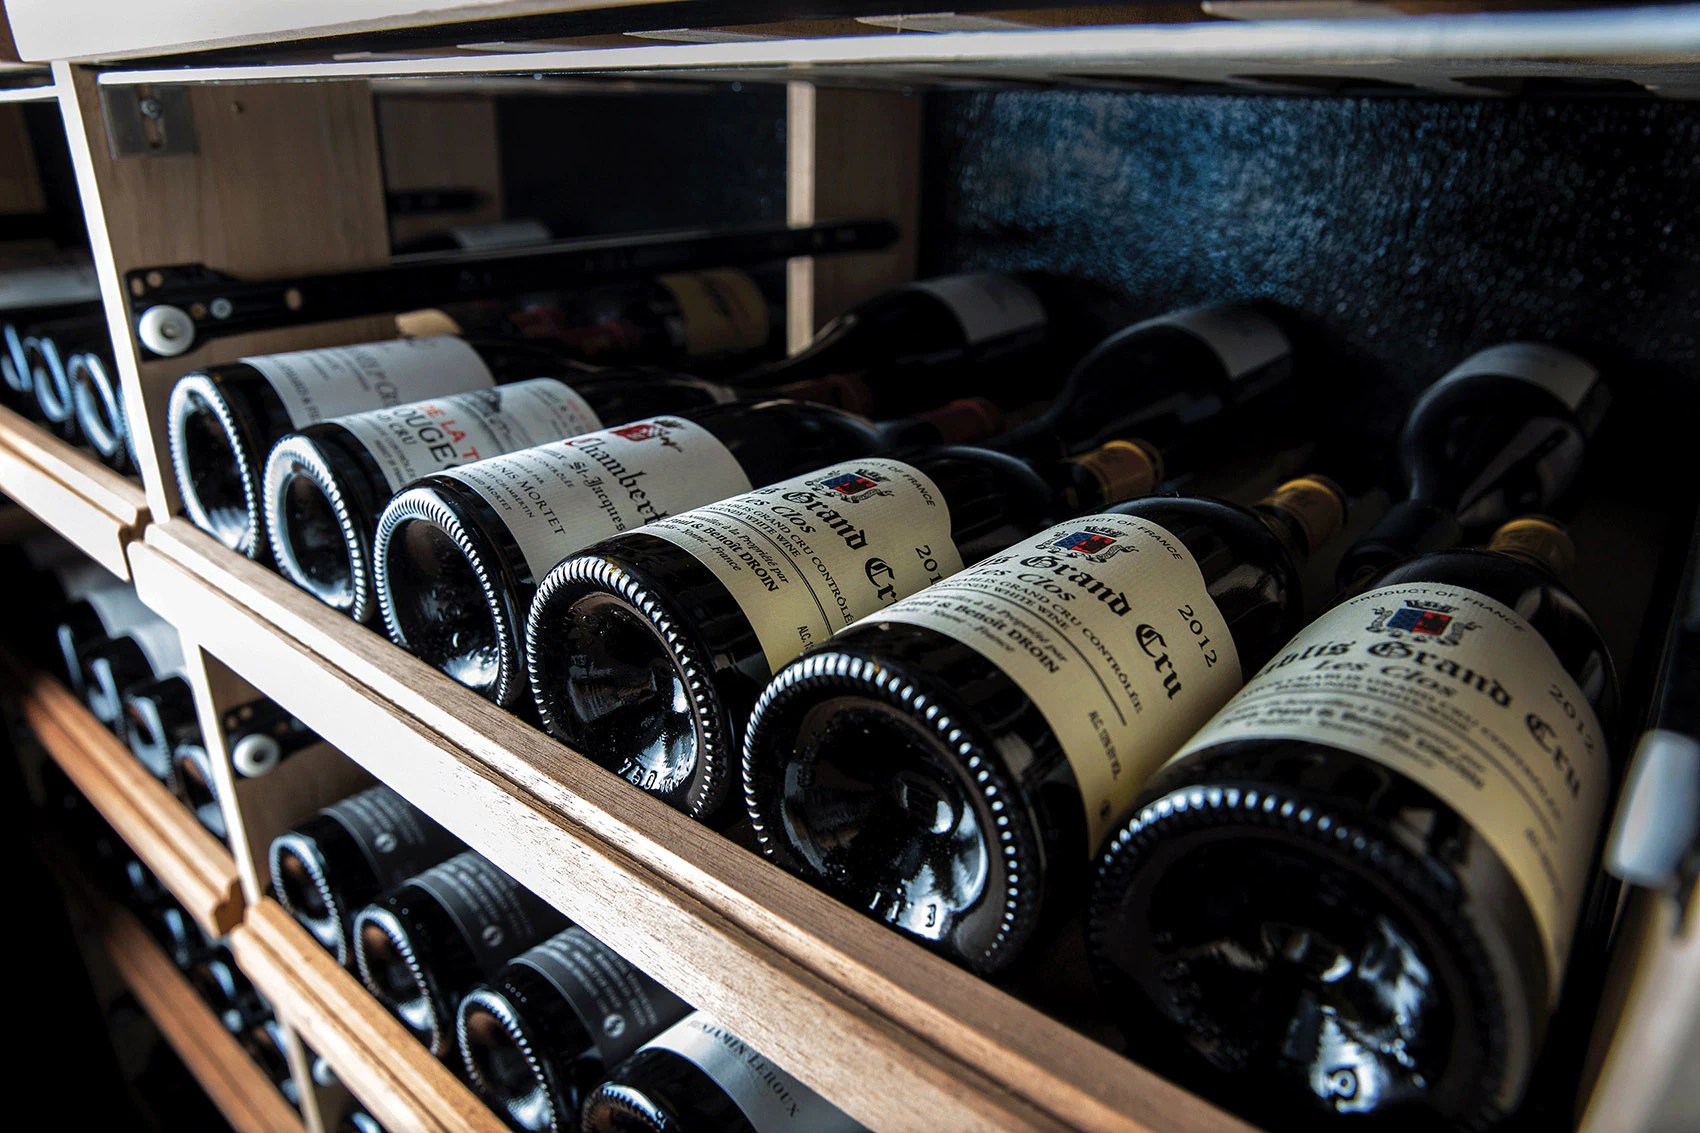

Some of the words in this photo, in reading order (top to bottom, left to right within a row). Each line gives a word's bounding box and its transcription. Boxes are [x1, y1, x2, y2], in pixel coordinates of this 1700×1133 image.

[440, 420, 466, 443] LA
[484, 485, 513, 512] MORTET
[518, 480, 567, 535] MORTET
[888, 466, 906, 474] OF
[903, 473, 936, 507] FRANCE
[744, 514, 778, 535] WHITE
[776, 534, 801, 558] WINE
[753, 509, 791, 535] GRAND
[790, 534, 813, 555] CRU
[770, 505, 816, 534] Clos
[703, 526, 743, 553] Benoît
[738, 551, 780, 592] DROIN
[711, 545, 742, 572] France
[737, 532, 778, 567] Propriété
[769, 566, 790, 584] par
[781, 491, 869, 551] Grand
[864, 557, 900, 607] Cr
[1137, 525, 1184, 561] FRANCE
[992, 586, 1036, 608] WHITE
[1036, 605, 1072, 632] WINE
[999, 580, 1050, 604] GRAND
[1050, 603, 1083, 627] CRU
[1016, 573, 1077, 602] Clos
[1019, 555, 1133, 617] Grand
[1135, 623, 1183, 700] Cru
[1349, 588, 1431, 606] PRODUCT
[1434, 588, 1461, 599] OF
[1460, 595, 1529, 634] FRANCE
[1006, 628, 1062, 675] DROIN
[1176, 603, 1219, 669] 2012
[1378, 665, 1458, 699] Clos
[1366, 640, 1515, 709] Grand
[1524, 711, 1583, 800] Cru
